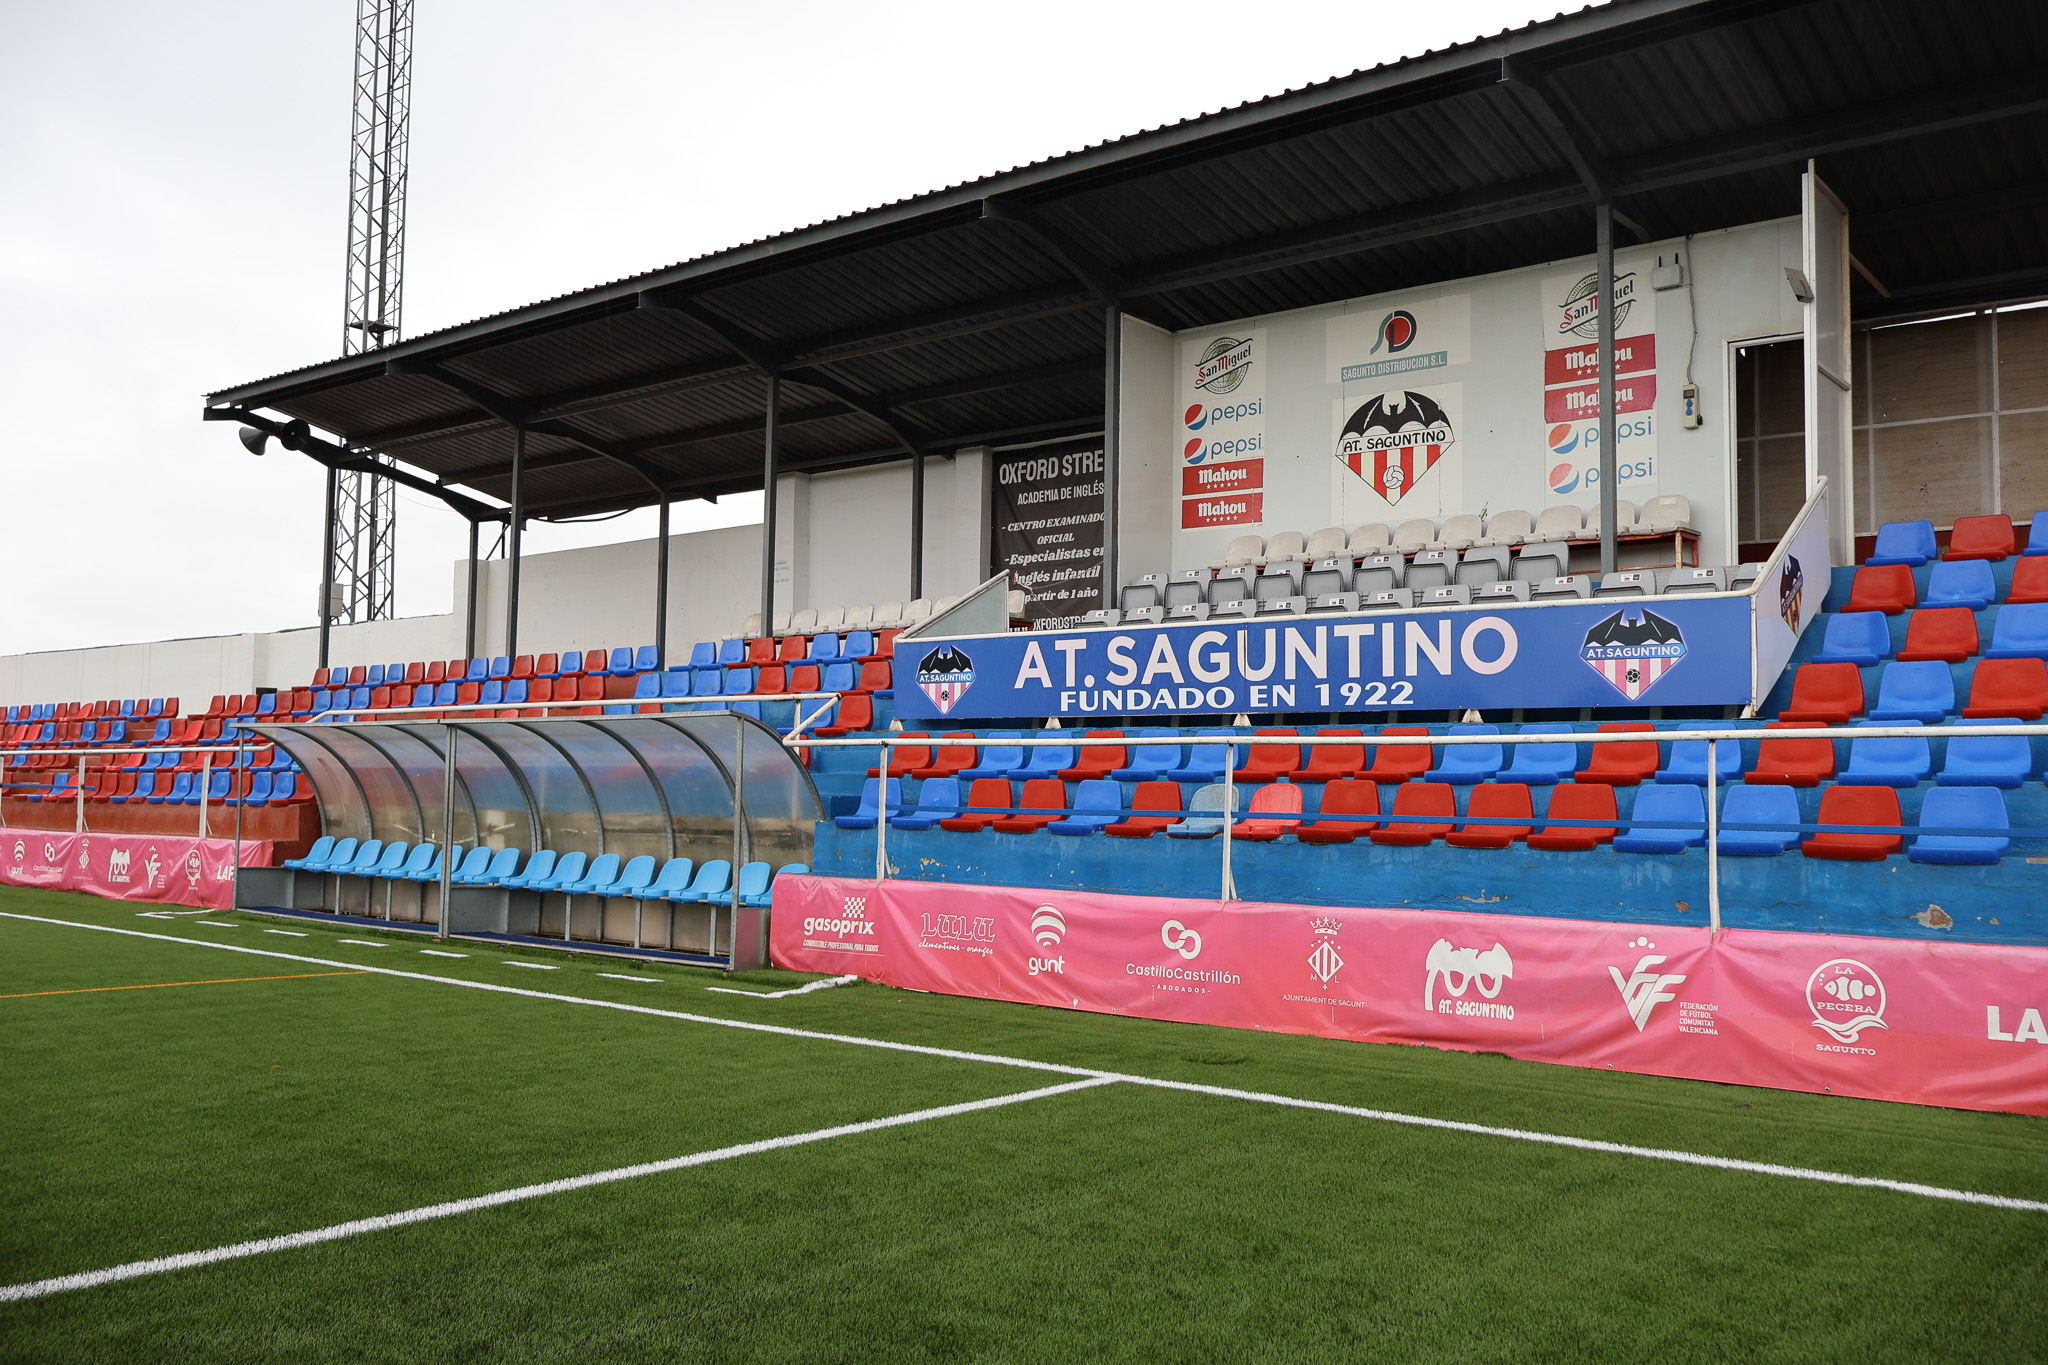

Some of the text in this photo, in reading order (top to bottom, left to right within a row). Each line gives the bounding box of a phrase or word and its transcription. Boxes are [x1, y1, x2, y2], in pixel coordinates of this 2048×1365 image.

[1560, 280, 1634, 329] San Muel
[1195, 365, 1217, 386] San
[1216, 344, 1251, 371] Miguel
[1343, 354, 1446, 380] SAGUNTO DISTRIBUCION S.L.
[1211, 398, 1262, 425] pepsi
[1344, 430, 1446, 453] AT. SAGUNTINO
[1585, 415, 1652, 448] ppsi
[1211, 433, 1262, 460] pepsi
[1000, 450, 1104, 485] OXFORD STRE
[1198, 466, 1247, 484] Mahou
[1585, 457, 1653, 488] ppsi
[1018, 480, 1105, 506] ACADEMIA DE INGLÉS
[1198, 500, 1247, 517] Mahou
[1007, 520, 1045, 532] CENTRO
[1036, 533, 1075, 545] OFICIAL
[1051, 565, 1101, 581] infantil
[1057, 589, 1069, 600] de
[1076, 587, 1099, 598] año
[1014, 615, 1518, 689] AT. SAGUNTINO
[1587, 645, 1681, 658] AT. SAGUNTINO
[919, 673, 972, 682] AT. SAGUNTINO
[1060, 681, 1414, 712] FUNDADO EN 1922
[216, 865, 235, 880] LAF
[803, 916, 875, 938] gasoprix
[921, 912, 996, 942] LULU
[1028, 955, 1066, 976] gunt
[1126, 963, 1241, 985] CastilloCastrillón
[1834, 966, 1855, 975] LA
[1282, 994, 1365, 1008] AJUNTAMENT DE SAGUNT
[1438, 998, 1515, 1020] AT. SAGUNTINO
[1679, 1001, 1719, 1012] FEDERACIÓN
[1816, 1002, 1875, 1014] PECERA
[1679, 1018, 1715, 1027] COMUNITAT
[1689, 1009, 1713, 1019] FÚTBOL
[1987, 1005, 2048, 1044] LA
[1679, 1026, 1719, 1035] VALENCIANA
[1816, 1044, 1876, 1056] SAGUNTO
